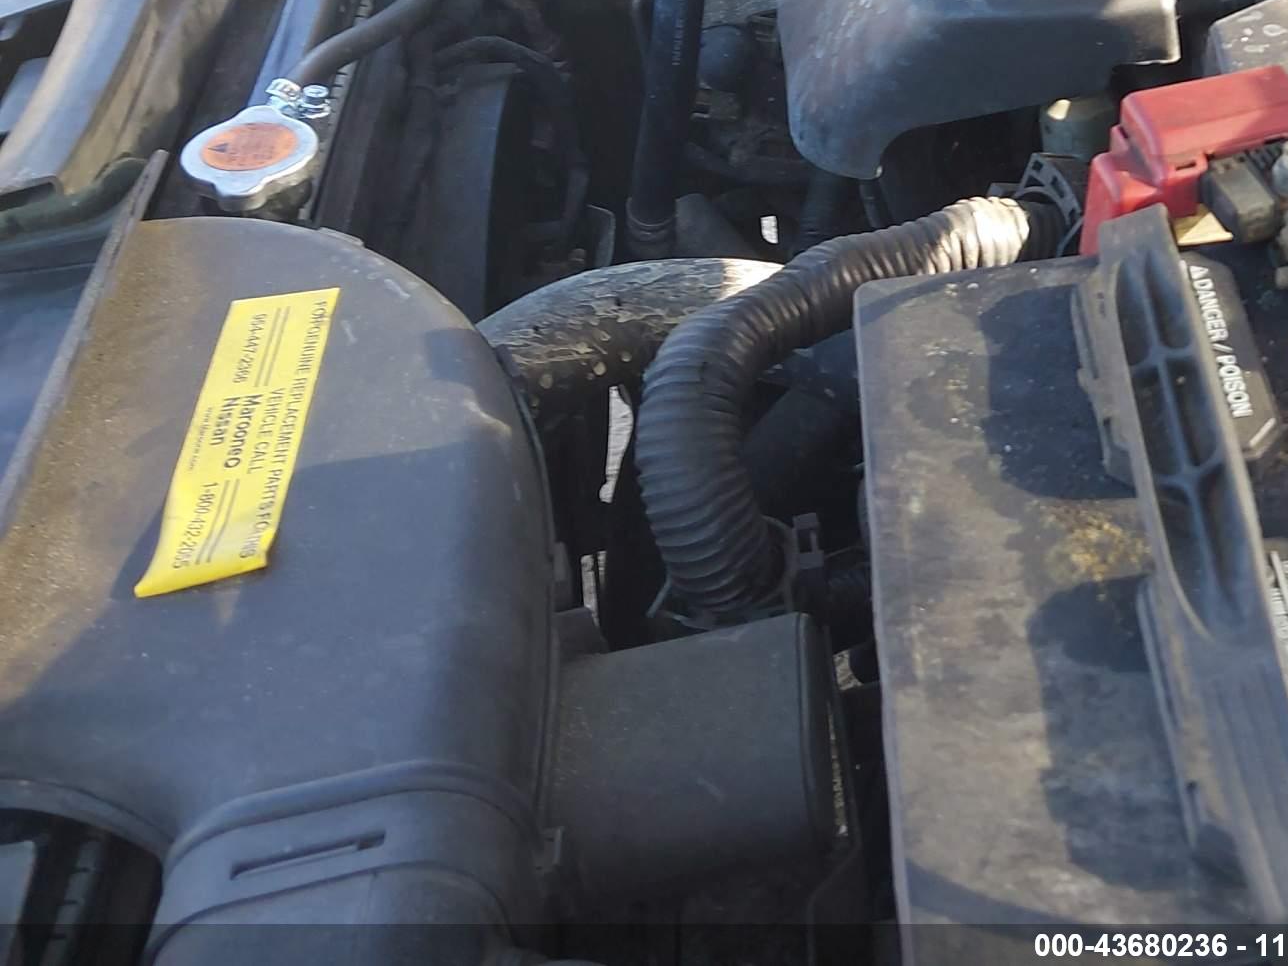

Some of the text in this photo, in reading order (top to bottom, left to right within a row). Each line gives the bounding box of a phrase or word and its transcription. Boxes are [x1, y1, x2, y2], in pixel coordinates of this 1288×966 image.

[297, 324, 322, 373] GENUINE
[1194, 276, 1228, 344] DANGER
[1216, 352, 1253, 420] POISON
[212, 397, 240, 445] Nissan
[246, 388, 284, 474] VEHICLE CALL
[271, 378, 305, 464] REPLACEMENT
[257, 469, 282, 510] PARTS
